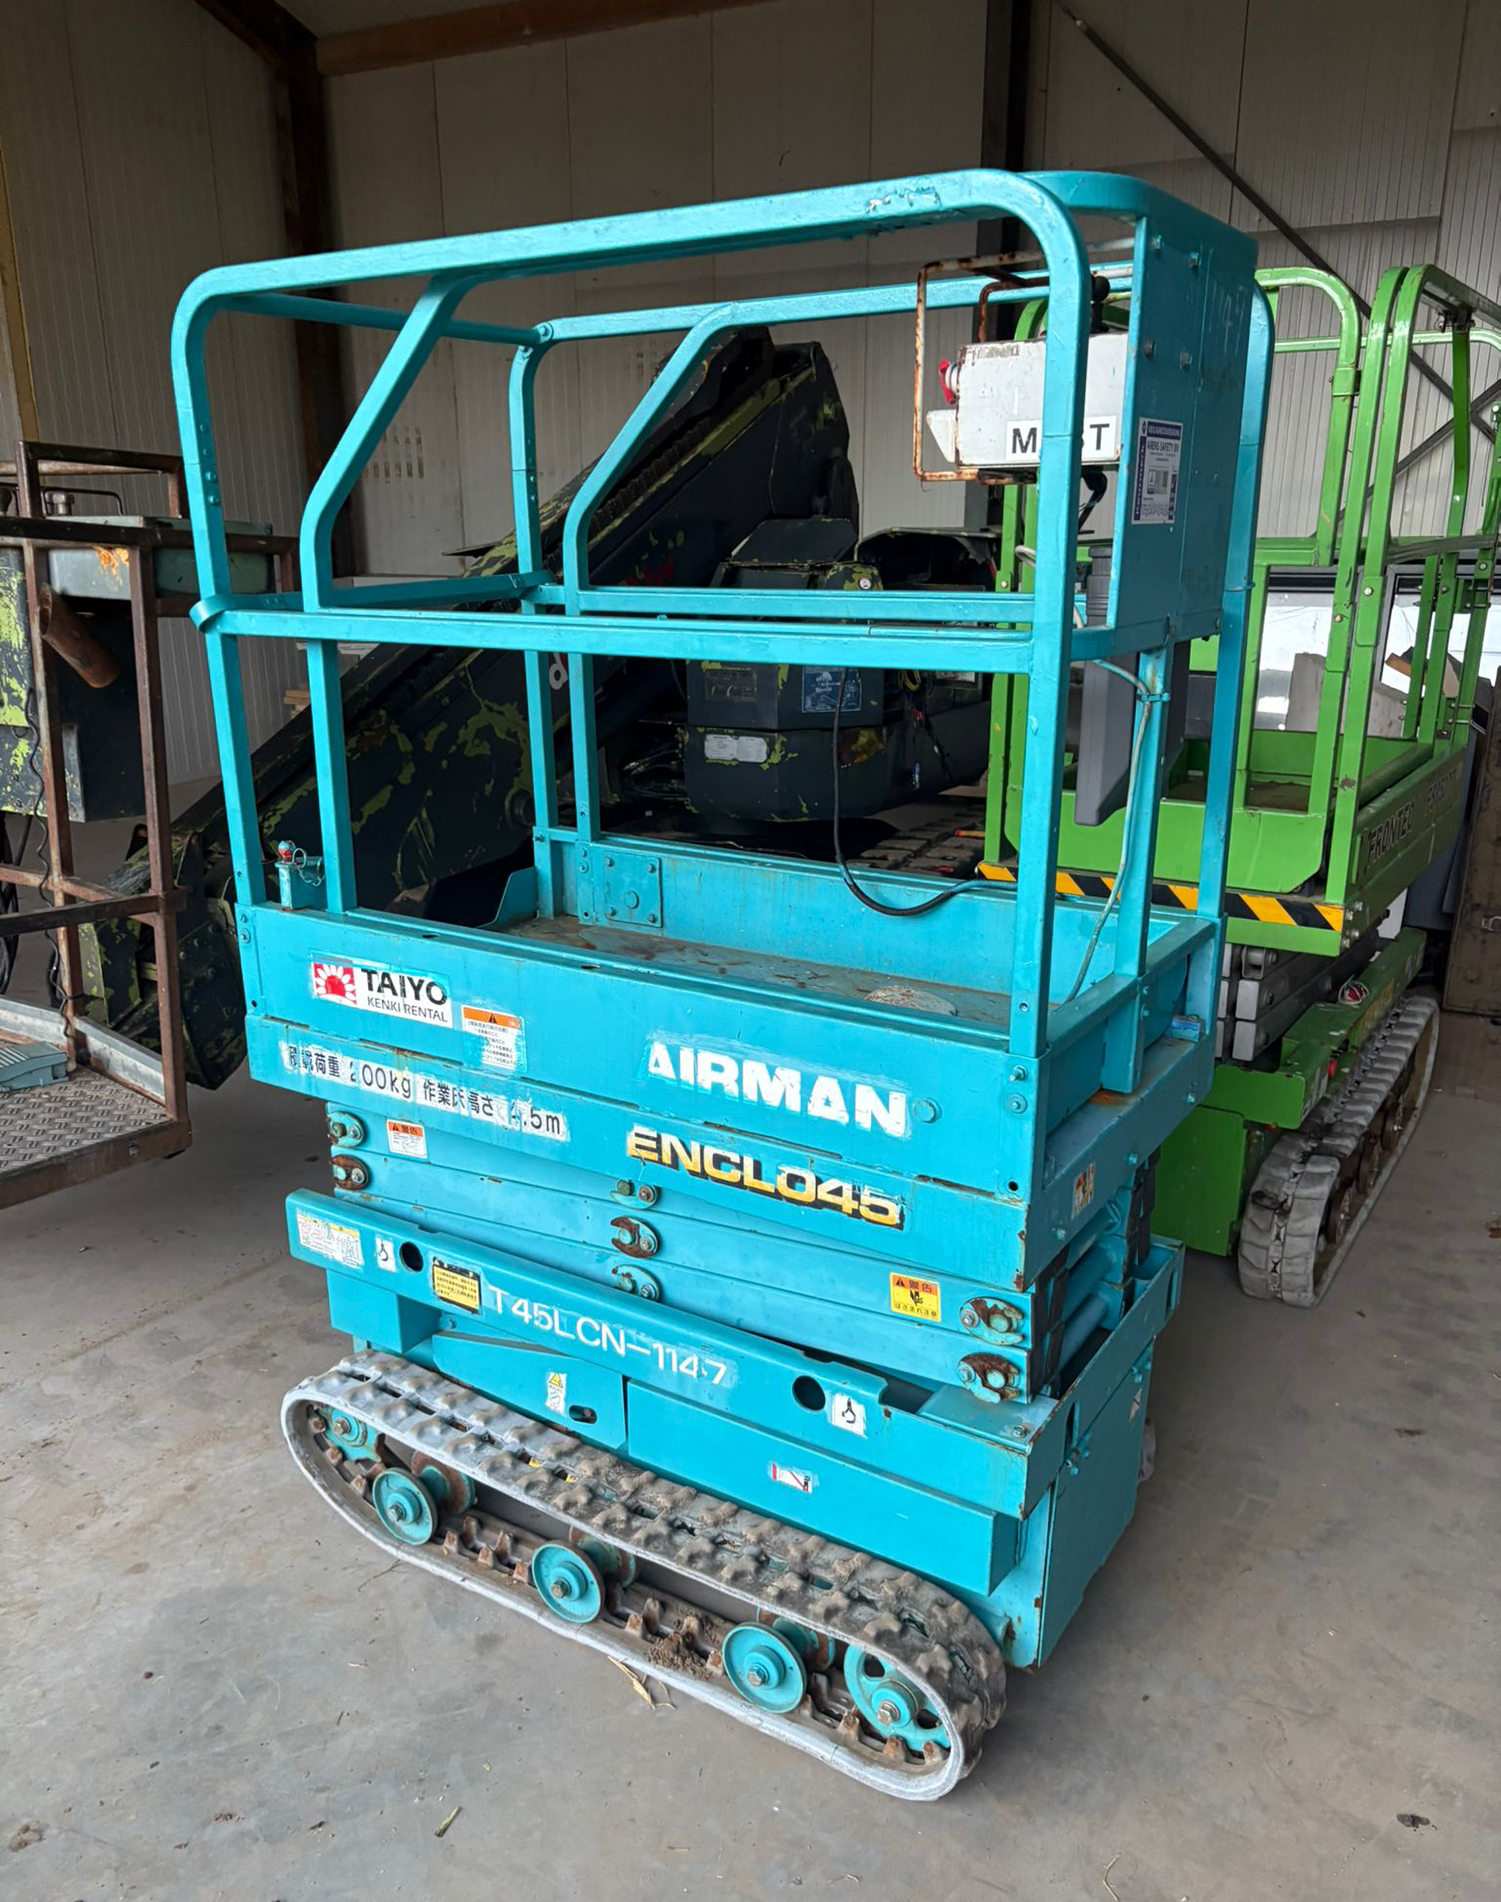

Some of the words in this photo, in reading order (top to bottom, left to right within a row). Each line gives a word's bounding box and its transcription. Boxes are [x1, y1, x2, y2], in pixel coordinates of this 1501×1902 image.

[1012, 423, 1110, 454] MT
[361, 968, 447, 1005] TAIYO
[367, 996, 402, 1013] KENKI
[403, 1003, 448, 1022] RENTAL
[647, 1041, 907, 1138] AIRMAN
[487, 1285, 727, 1385] T45LCN-1147
